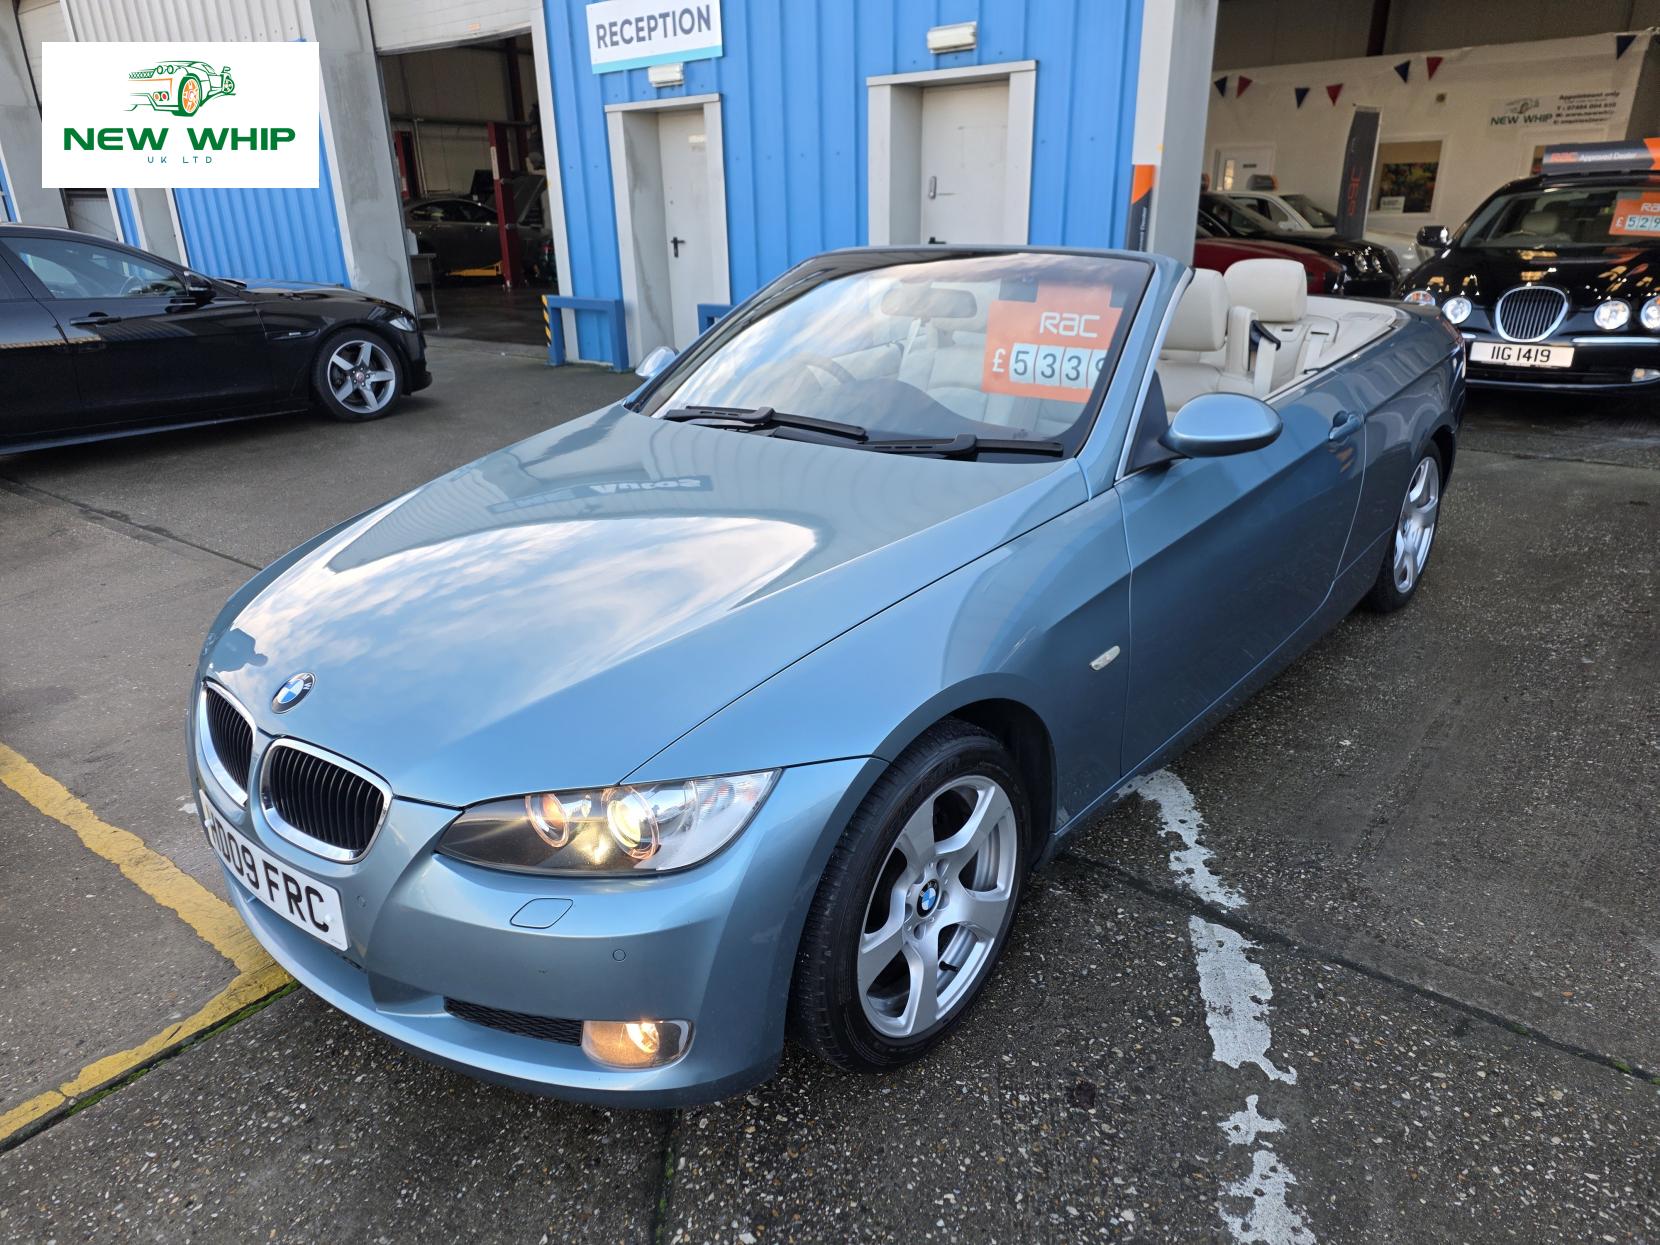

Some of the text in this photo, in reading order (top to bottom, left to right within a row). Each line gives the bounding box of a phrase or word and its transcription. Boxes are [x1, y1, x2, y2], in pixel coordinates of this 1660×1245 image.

[595, 4, 711, 49] RECEPTION
[1559, 89, 1620, 102] Appointment only
[1490, 115, 1520, 126] NEW
[1523, 113, 1553, 123] WHIP
[1579, 152, 1613, 162] Approved
[1614, 152, 1637, 160] Dealer
[1517, 348, 1551, 363] 1419
[262, 859, 330, 933] FRC
